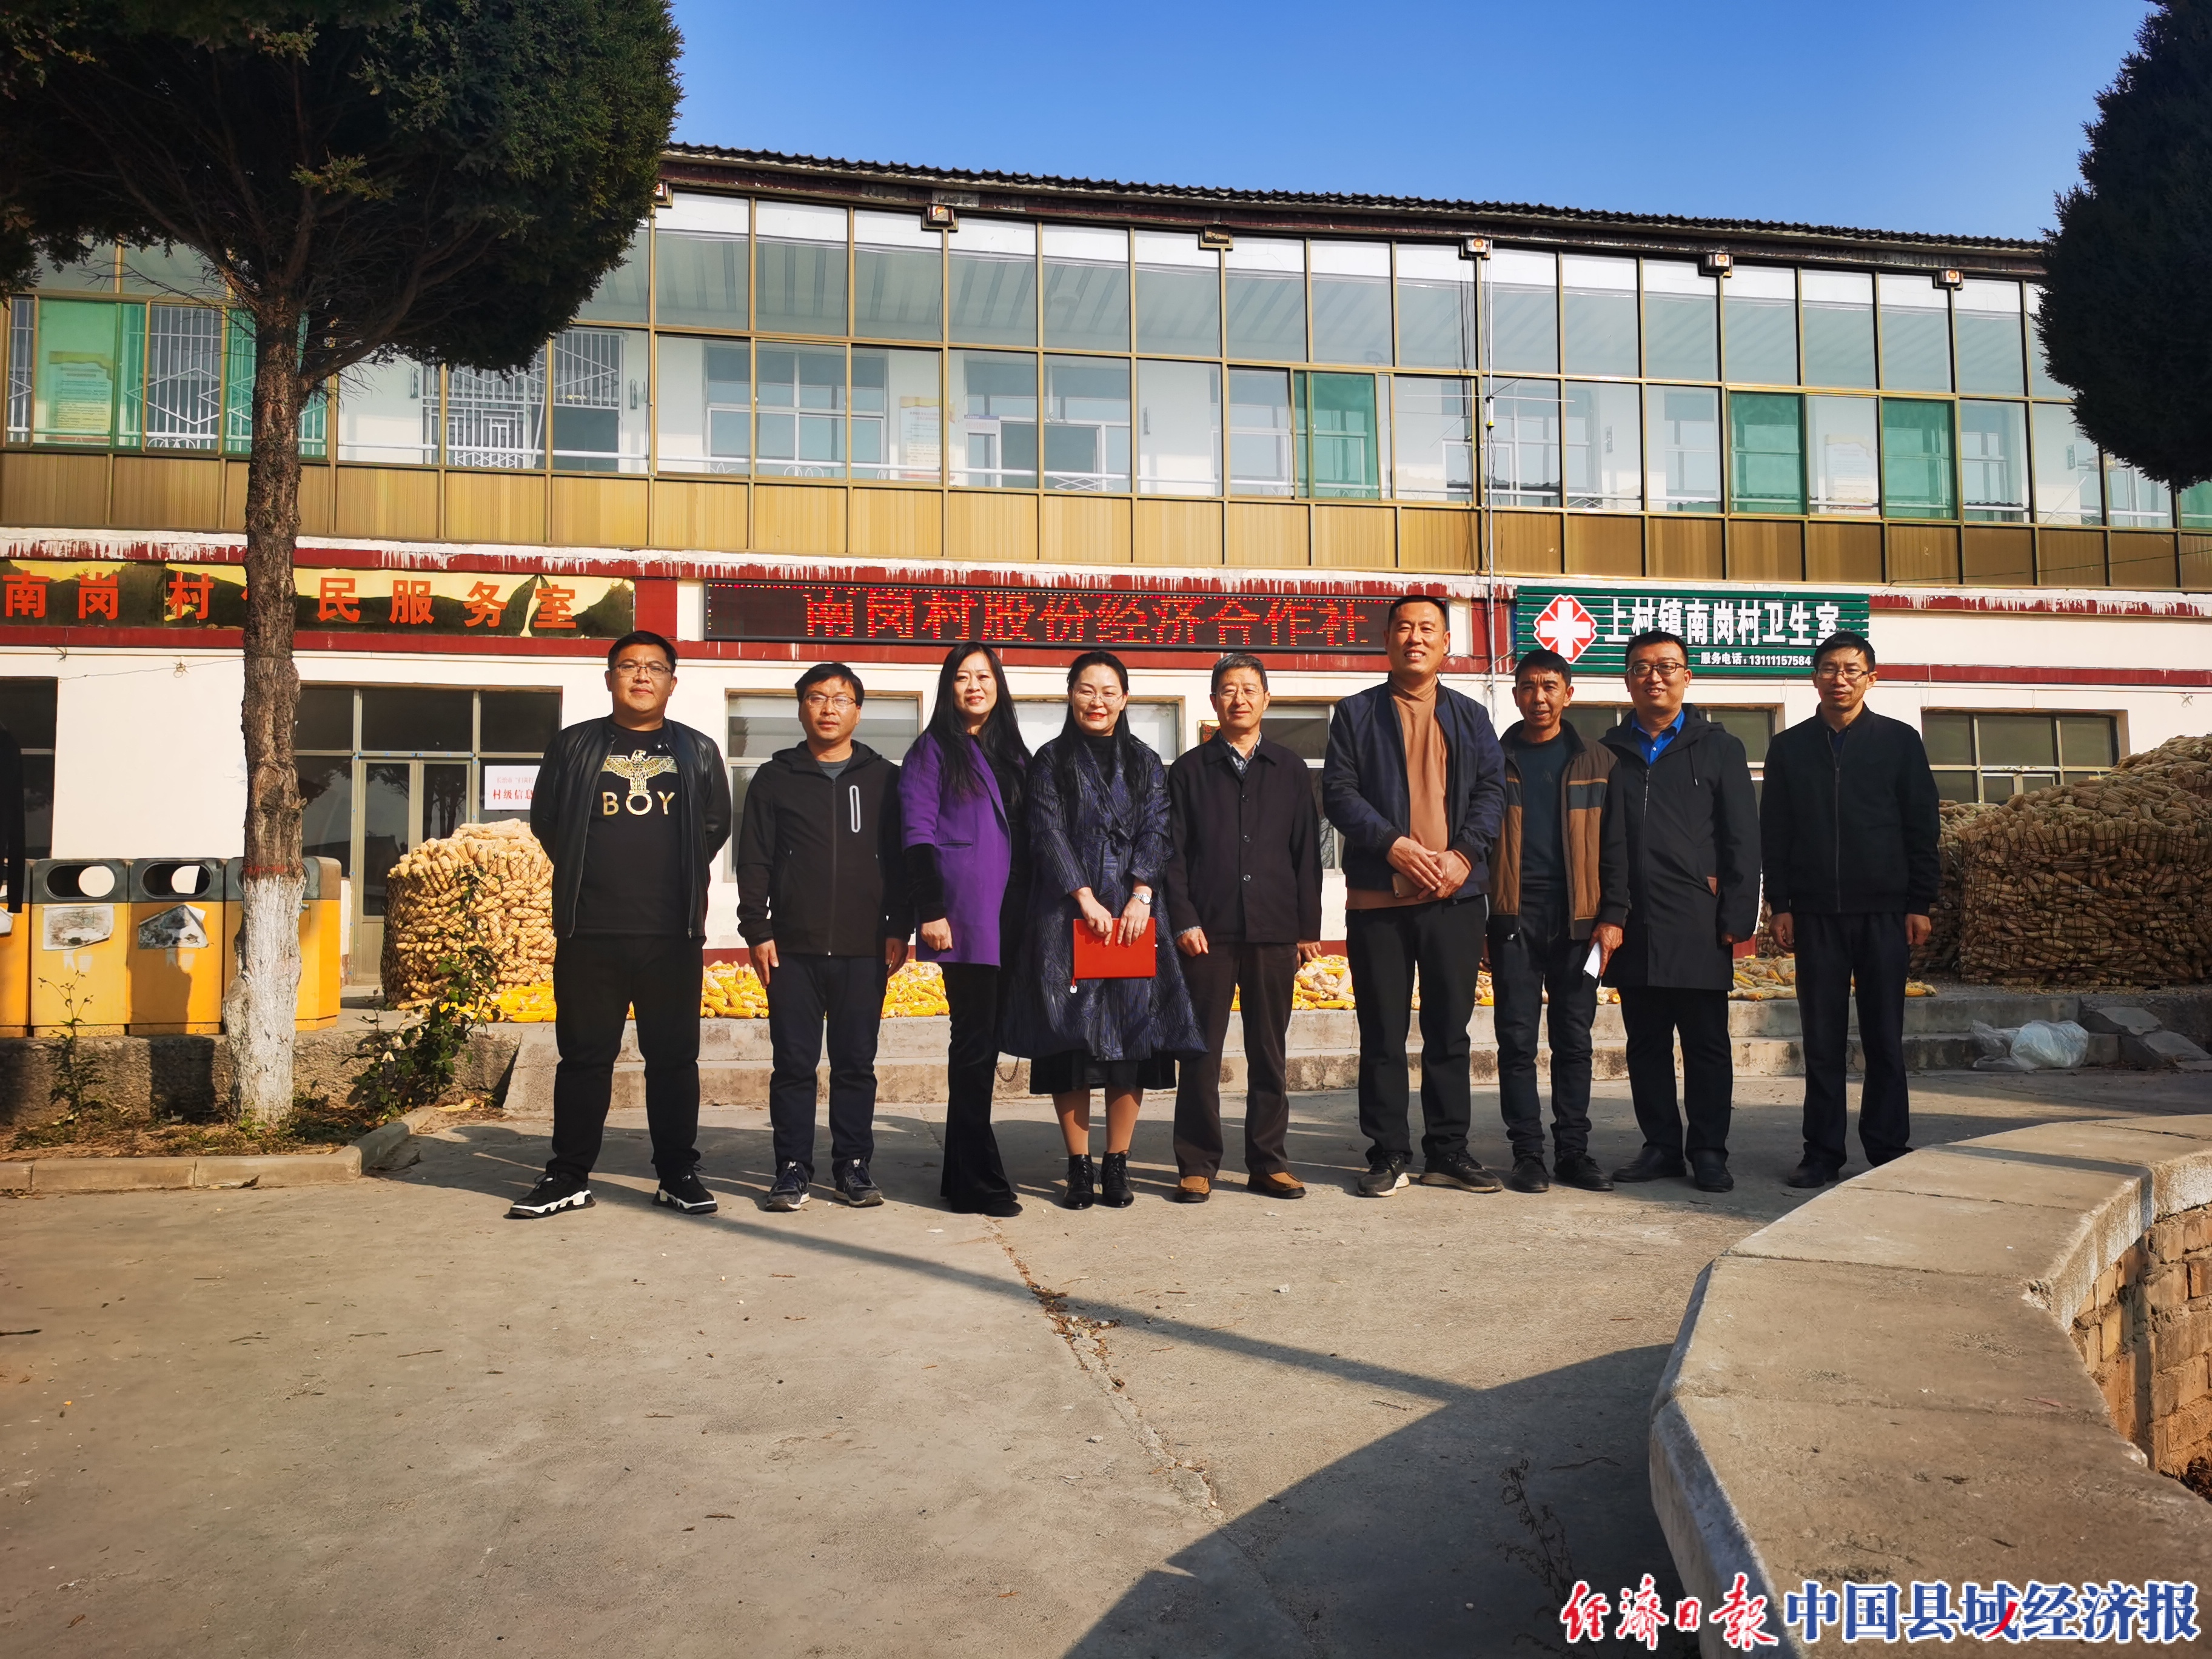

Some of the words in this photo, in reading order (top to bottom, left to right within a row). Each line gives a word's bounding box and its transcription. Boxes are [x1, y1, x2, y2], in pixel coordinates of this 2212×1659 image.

[2, 570, 577, 628] 南岗村民服务室
[802, 589, 1369, 646] 南岗村股份经济合作社
[1604, 597, 1840, 646] 上村镇南岗村卫生室
[602, 791, 675, 816] BOY
